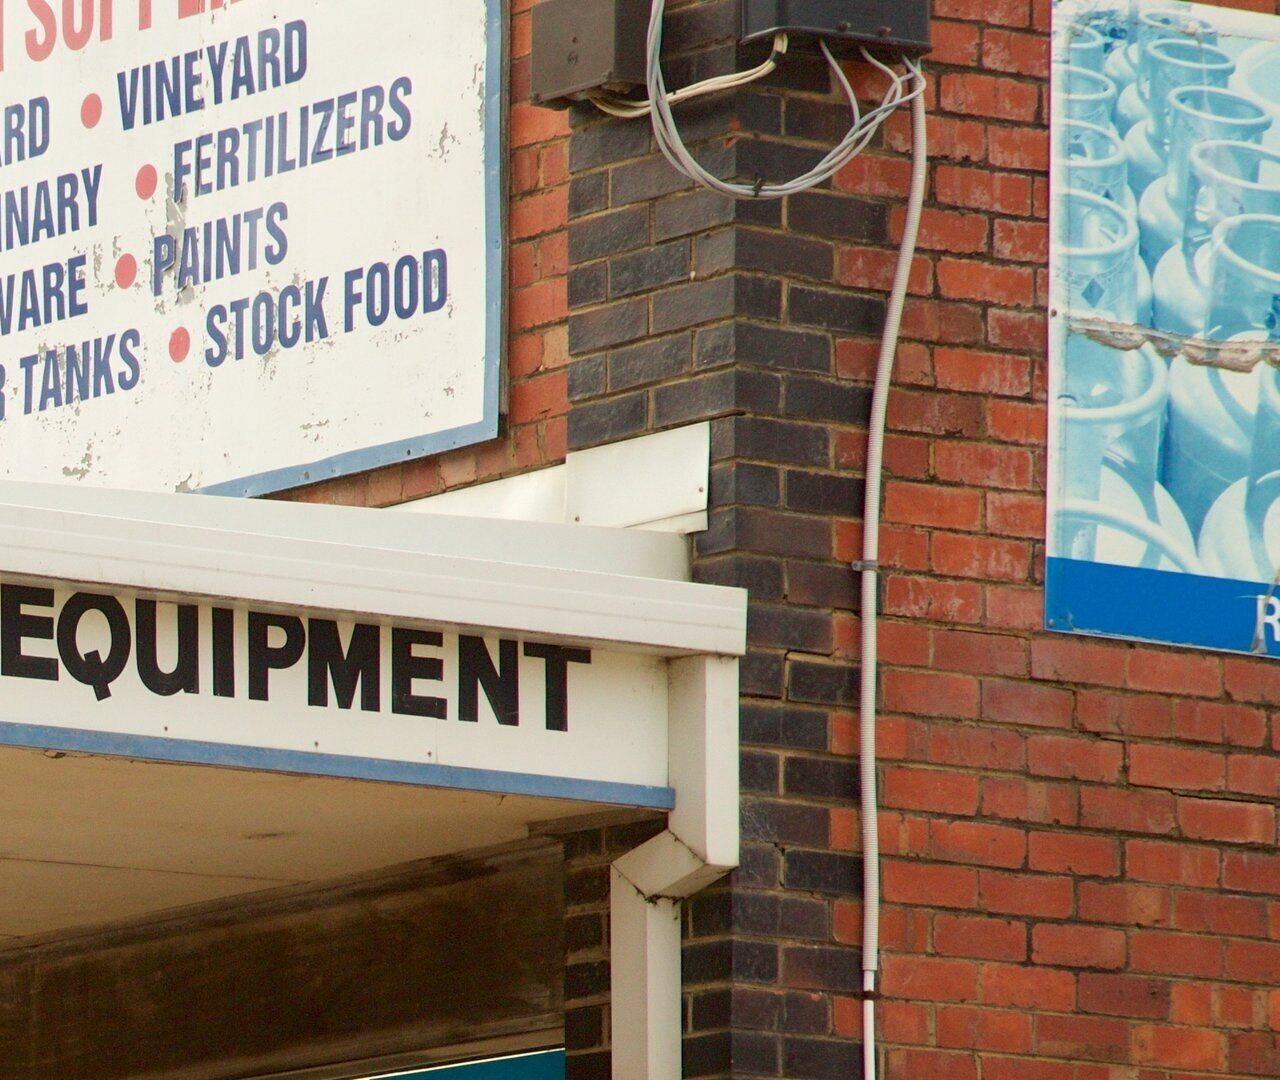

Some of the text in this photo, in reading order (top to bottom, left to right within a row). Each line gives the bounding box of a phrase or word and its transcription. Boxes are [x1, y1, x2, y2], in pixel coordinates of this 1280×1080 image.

[116, 19, 308, 131] VINEYARD
[173, 76, 412, 202] FERTILIZERS
[152, 202, 289, 297] PAINTS
[19, 328, 141, 416] TANKS
[205, 284, 328, 368] STOCK
[343, 247, 448, 333] FOOD
[0, 583, 592, 733] EQUIPMENT
